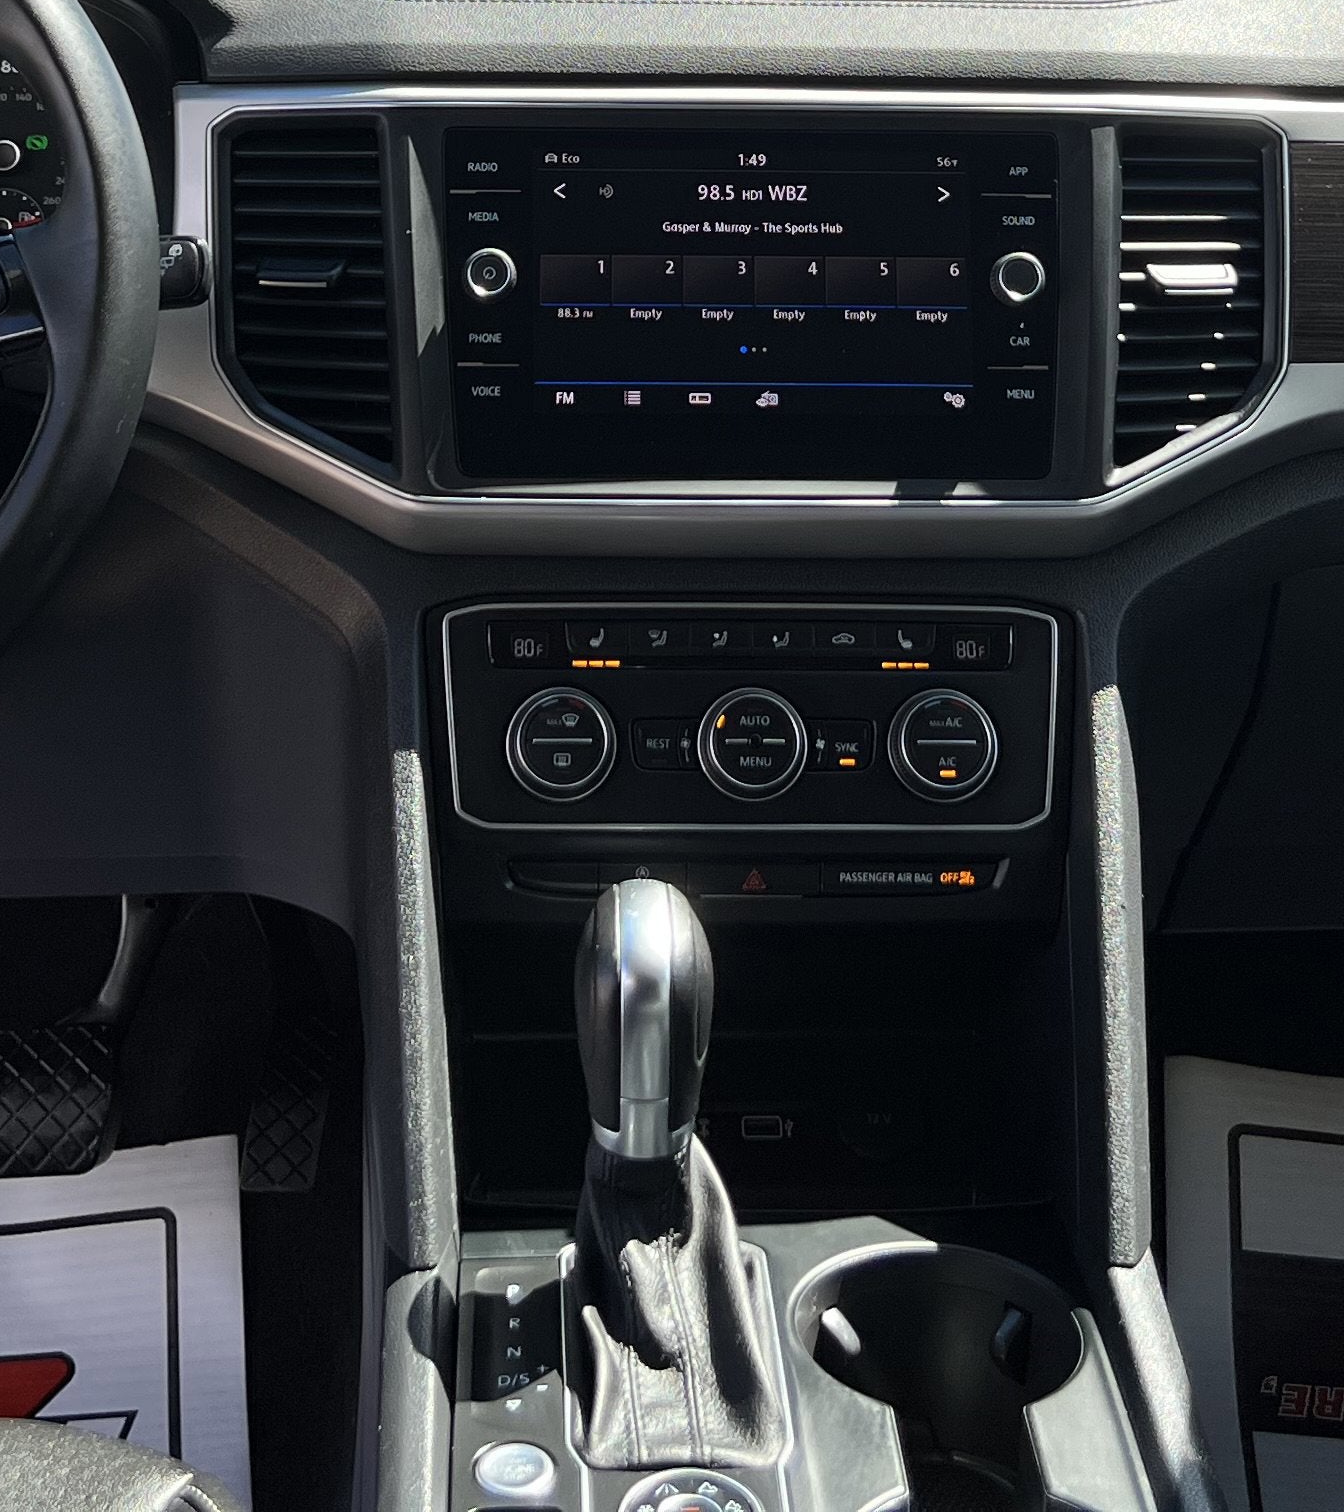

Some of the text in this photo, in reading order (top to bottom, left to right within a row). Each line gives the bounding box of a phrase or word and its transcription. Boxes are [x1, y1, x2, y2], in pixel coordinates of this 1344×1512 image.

[15, 92, 32, 102] 140
[561, 153, 581, 164] Eco
[737, 153, 767, 167] 1:49
[467, 162, 498, 173] RADIO
[1008, 165, 1029, 177] APP
[697, 184, 808, 201] 98.5 HD1 WBZ
[468, 212, 499, 222] MEDIA
[1001, 215, 1036, 226] SOUND
[662, 221, 844, 236] Gasper & Murray The Sports Hub
[597, 260, 605, 274] 1
[665, 260, 675, 275] 2
[737, 261, 747, 275] 3
[807, 261, 818, 276] 4
[880, 262, 889, 276] 5
[949, 263, 960, 277] 6
[557, 308, 581, 319] 88.3
[630, 308, 663, 321] Empty
[701, 308, 734, 321] Empty
[773, 309, 806, 322] Empty
[844, 310, 877, 322] Empty
[915, 310, 949, 323] Empty
[468, 332, 503, 344] PHONE
[1009, 335, 1031, 347] CAR
[471, 386, 501, 397] VOICE
[555, 391, 575, 405] FM
[1006, 388, 1035, 400] MENU
[739, 714, 772, 727] AUTO
[945, 716, 964, 728] A/C
[645, 738, 672, 750] REST
[834, 742, 860, 754] SYNC
[739, 756, 773, 768] MENU
[938, 756, 958, 767] A/C
[838, 871, 960, 884] PASSENGER AIR BAG OFF
[508, 1317, 522, 1330] R
[507, 1345, 523, 1359] N
[497, 1372, 531, 1387] D/S
